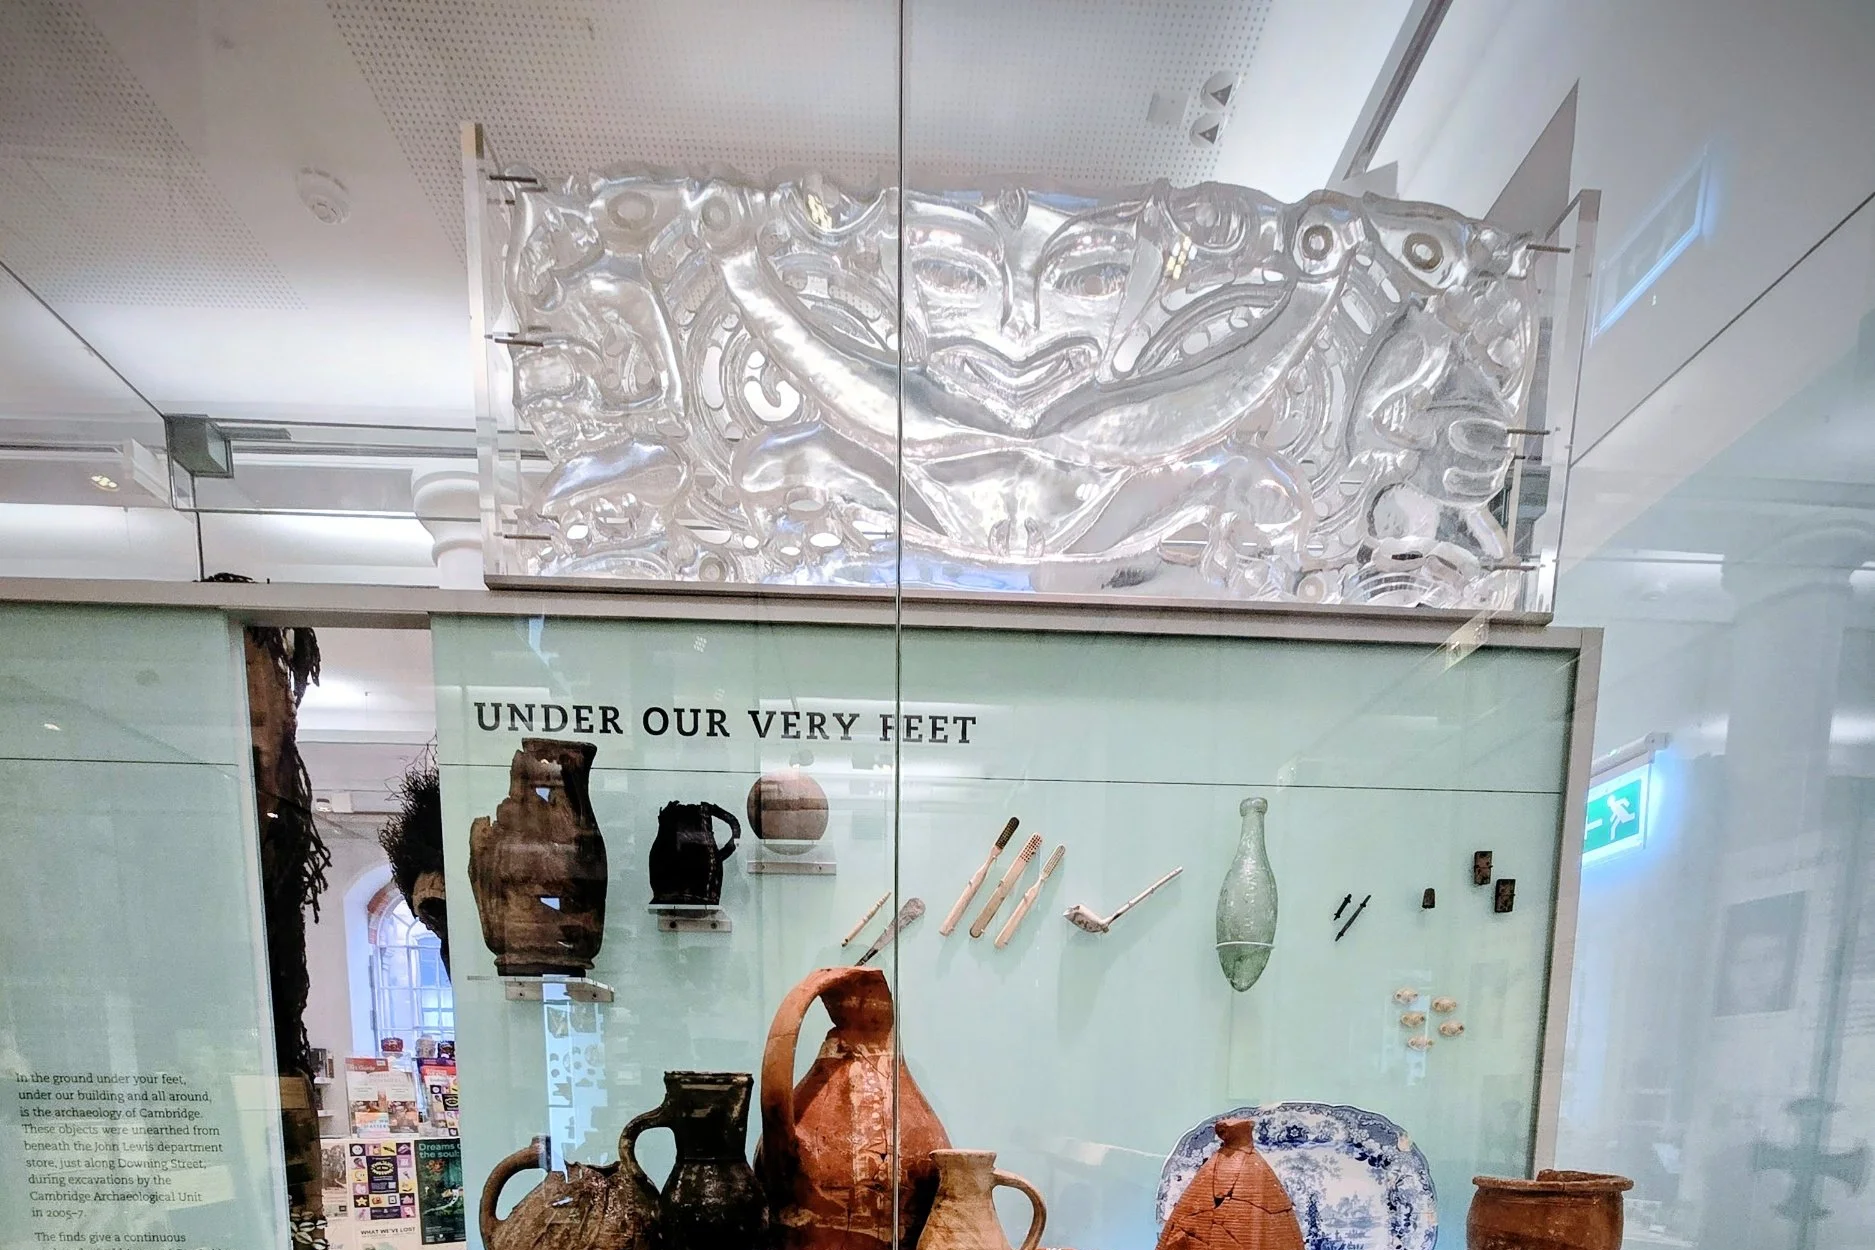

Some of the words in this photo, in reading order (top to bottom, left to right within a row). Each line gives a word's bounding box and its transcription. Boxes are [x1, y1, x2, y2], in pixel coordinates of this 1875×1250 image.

[474, 702, 623, 735] UNDER
[642, 706, 730, 738] OUR
[748, 709, 861, 741] VERY
[879, 713, 977, 744] FEET
[16, 1072, 28, 1083] In
[31, 1073, 50, 1083] the
[53, 1073, 93, 1085] ground
[97, 1074, 129, 1084] under
[133, 1075, 158, 1085] your
[162, 1074, 187, 1085] feet,
[18, 1089, 51, 1100] under
[55, 1091, 74, 1100] our
[77, 1090, 125, 1103] building
[127, 1091, 148, 1101] and
[151, 1091, 166, 1101] all
[169, 1091, 212, 1103] around,
[20, 1106, 30, 1117] is
[33, 1107, 52, 1117] the
[55, 1107, 122, 1120] archaeology
[125, 1108, 137, 1118] of
[21, 1123, 55, 1134] These
[59, 1123, 98, 1136] objects
[102, 1126, 129, 1135] were
[132, 1125, 190, 1135] unearthed
[193, 1125, 220, 1136] from
[24, 1140, 70, 1151] beneath
[73, 1140, 92, 1151] the
[94, 1142, 120, 1152] John
[123, 1141, 154, 1152] Lewis
[157, 1141, 223, 1154] department
[419, 1143, 455, 1151] Dreams
[26, 1159, 58, 1168] store,
[60, 1159, 81, 1169] just
[84, 1158, 115, 1170] along
[118, 1159, 168, 1171] Downing
[170, 1159, 206, 1169] Street,
[28, 1174, 66, 1187] during
[68, 1174, 134, 1184] excavations
[137, 1175, 150, 1187] by
[153, 1175, 172, 1185] the
[29, 1191, 91, 1203] Cambridge
[94, 1191, 175, 1204] Archaeological
[178, 1192, 203, 1201] Unit
[32, 1207, 43, 1217] in
[34, 1232, 56, 1241] The
[59, 1232, 86, 1241] finds
[89, 1232, 112, 1244] give
[124, 1232, 186, 1242] continuous
